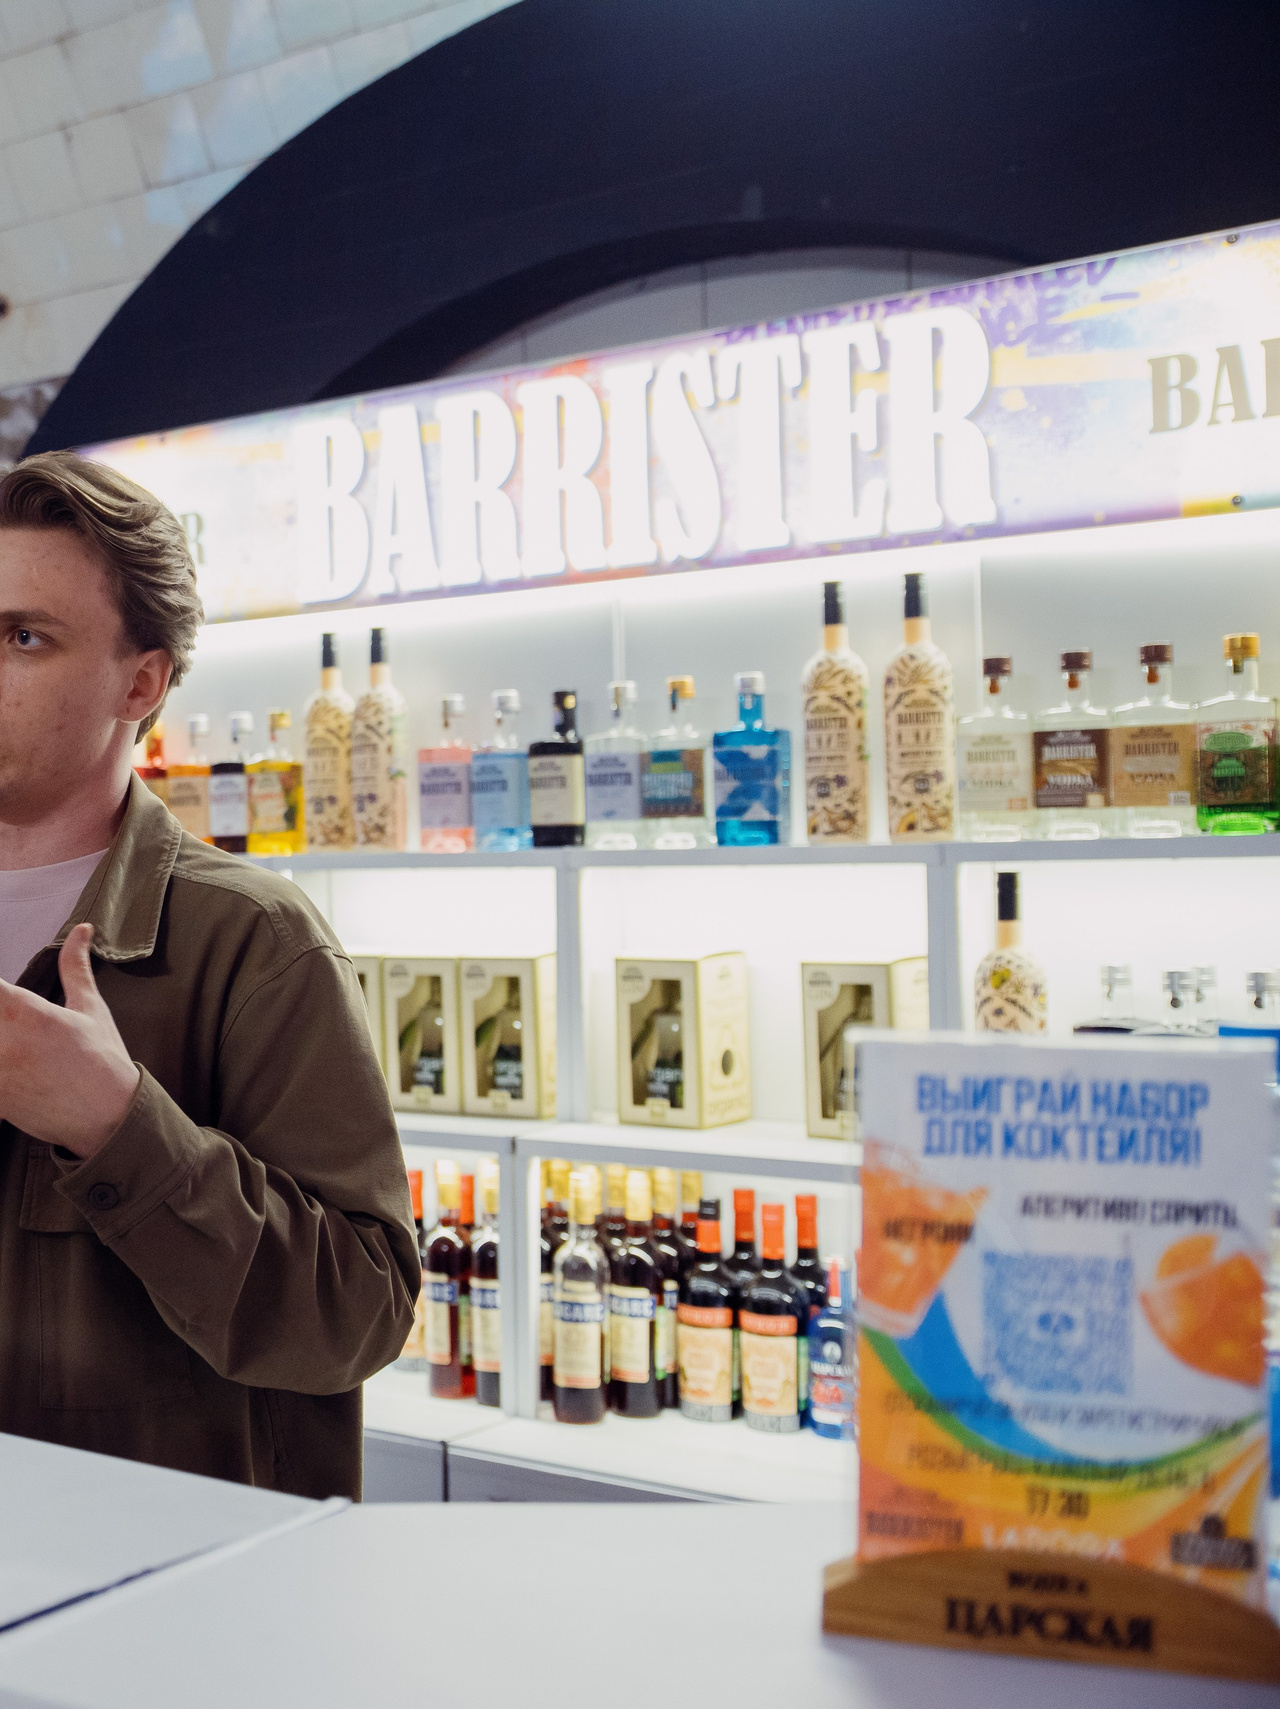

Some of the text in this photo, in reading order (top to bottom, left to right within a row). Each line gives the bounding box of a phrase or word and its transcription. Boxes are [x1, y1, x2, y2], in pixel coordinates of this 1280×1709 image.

[296, 305, 998, 604] BARRISTER
[915, 1069, 1210, 1123] ВЫИГРАЙ НАБОР
[923, 1118, 993, 1159] ДЛЯ
[945, 1597, 1156, 1653] ЦАРСКАЯ
